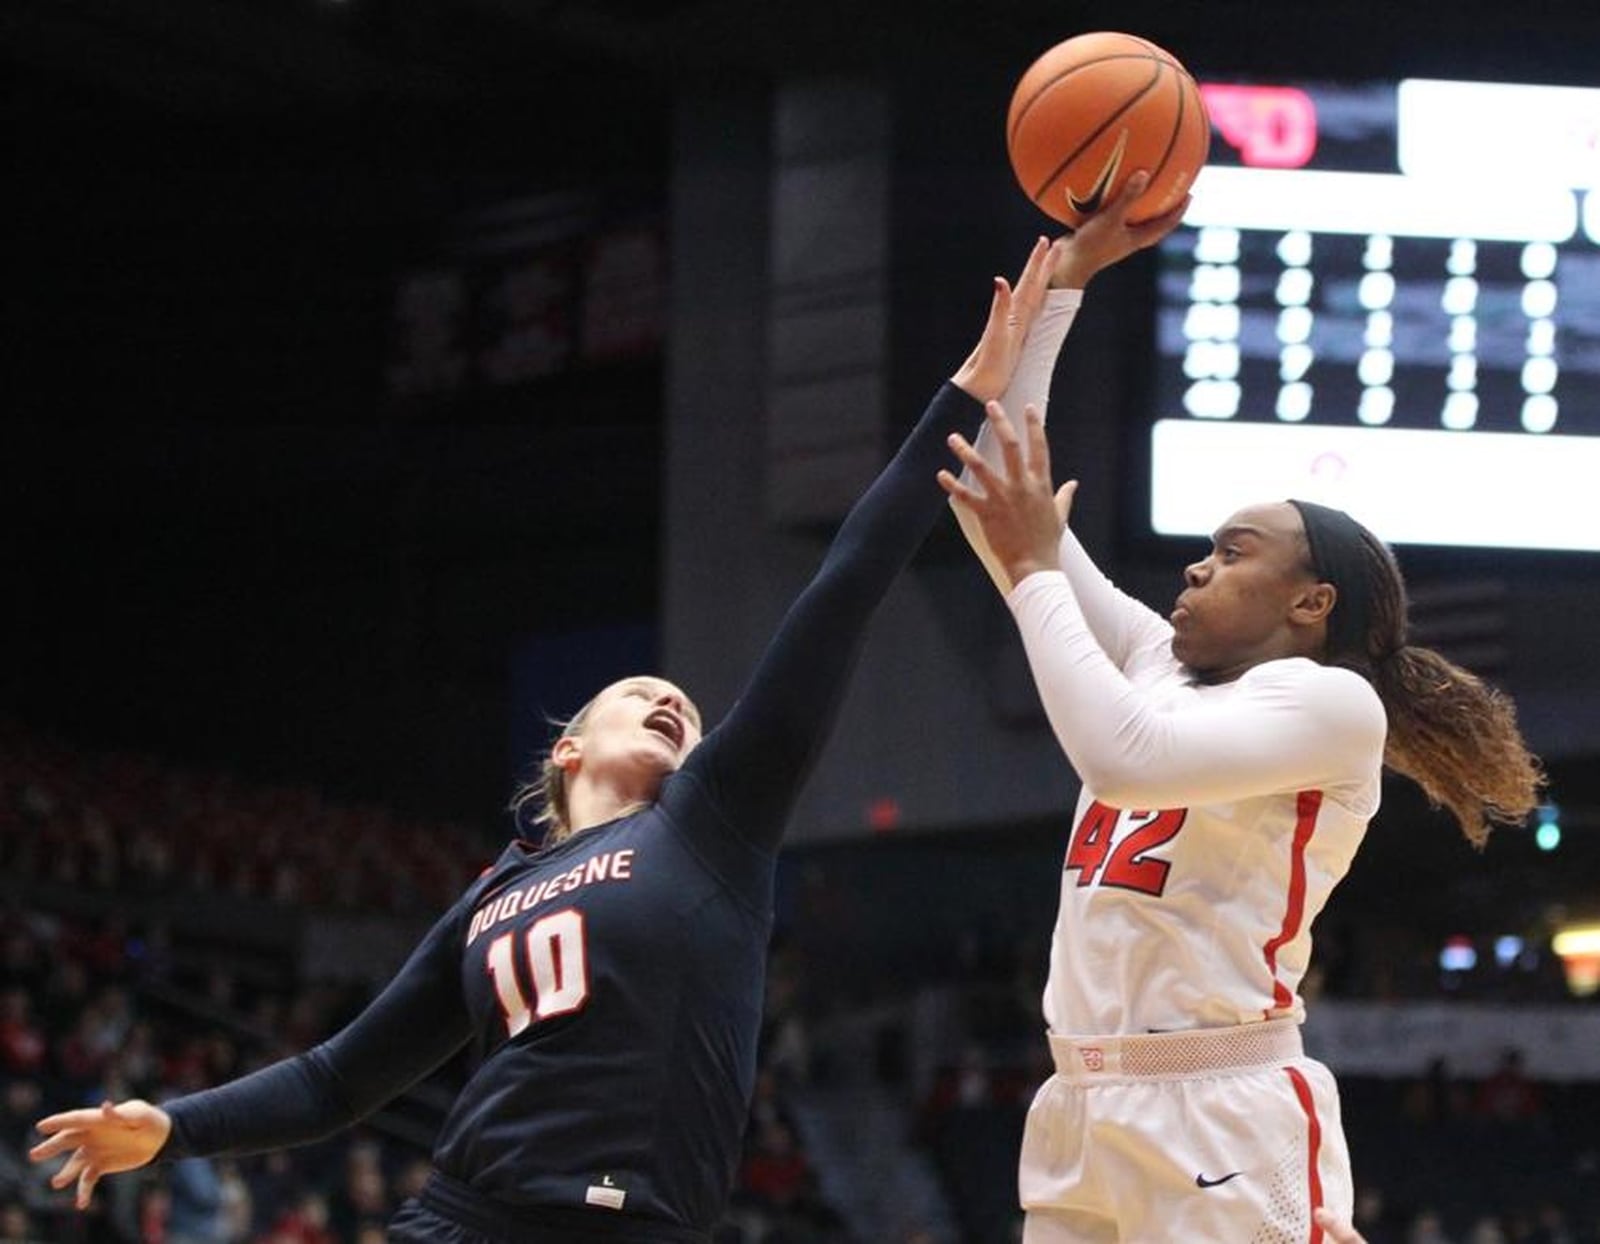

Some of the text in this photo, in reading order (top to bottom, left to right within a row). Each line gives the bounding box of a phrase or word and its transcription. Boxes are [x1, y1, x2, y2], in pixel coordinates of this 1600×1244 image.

[1064, 800, 1188, 898] 42
[466, 850, 634, 948] DUQUESNE
[486, 906, 591, 1039] 10
